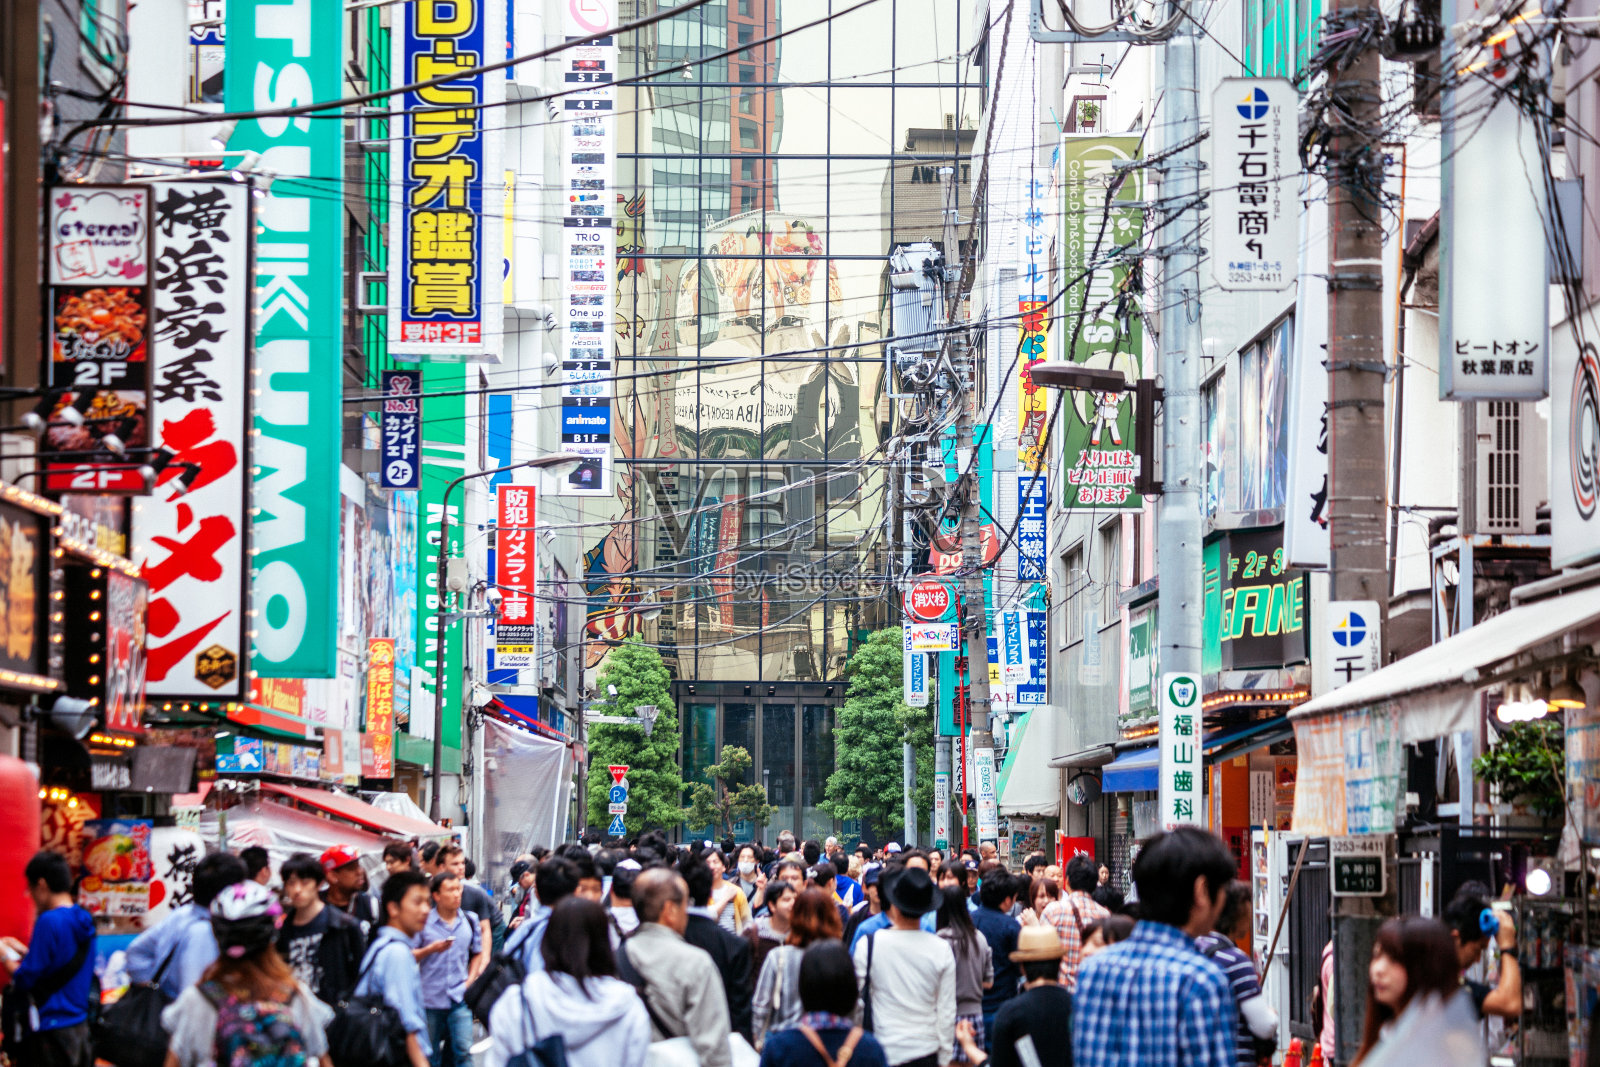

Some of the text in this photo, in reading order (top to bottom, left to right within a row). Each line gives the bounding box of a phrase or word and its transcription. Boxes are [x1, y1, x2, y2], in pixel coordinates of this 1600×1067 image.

[1237, 123, 1269, 236] 千石電商
[575, 233, 600, 242] TRIO
[1024, 178, 1044, 284] 北林ビル
[1228, 272, 1282, 283] 3253-4411
[569, 308, 604, 320] One up
[404, 323, 479, 343] 受付3F
[1455, 340, 1539, 355] ビートオン
[74, 361, 127, 386] 2F
[1461, 359, 1534, 376] 秋葉原店
[566, 413, 607, 425] animate
[385, 415, 401, 457] カフェ
[1076, 449, 1135, 467] 入り口は
[71, 465, 123, 489] 2F
[390, 465, 409, 480] 2F
[1078, 487, 1132, 504] あります
[504, 488, 530, 620] 防犯カメラ・工事
[1242, 550, 1268, 579] 2F
[914, 591, 946, 608] 消火栓
[1173, 714, 1193, 822] 福山歯科
